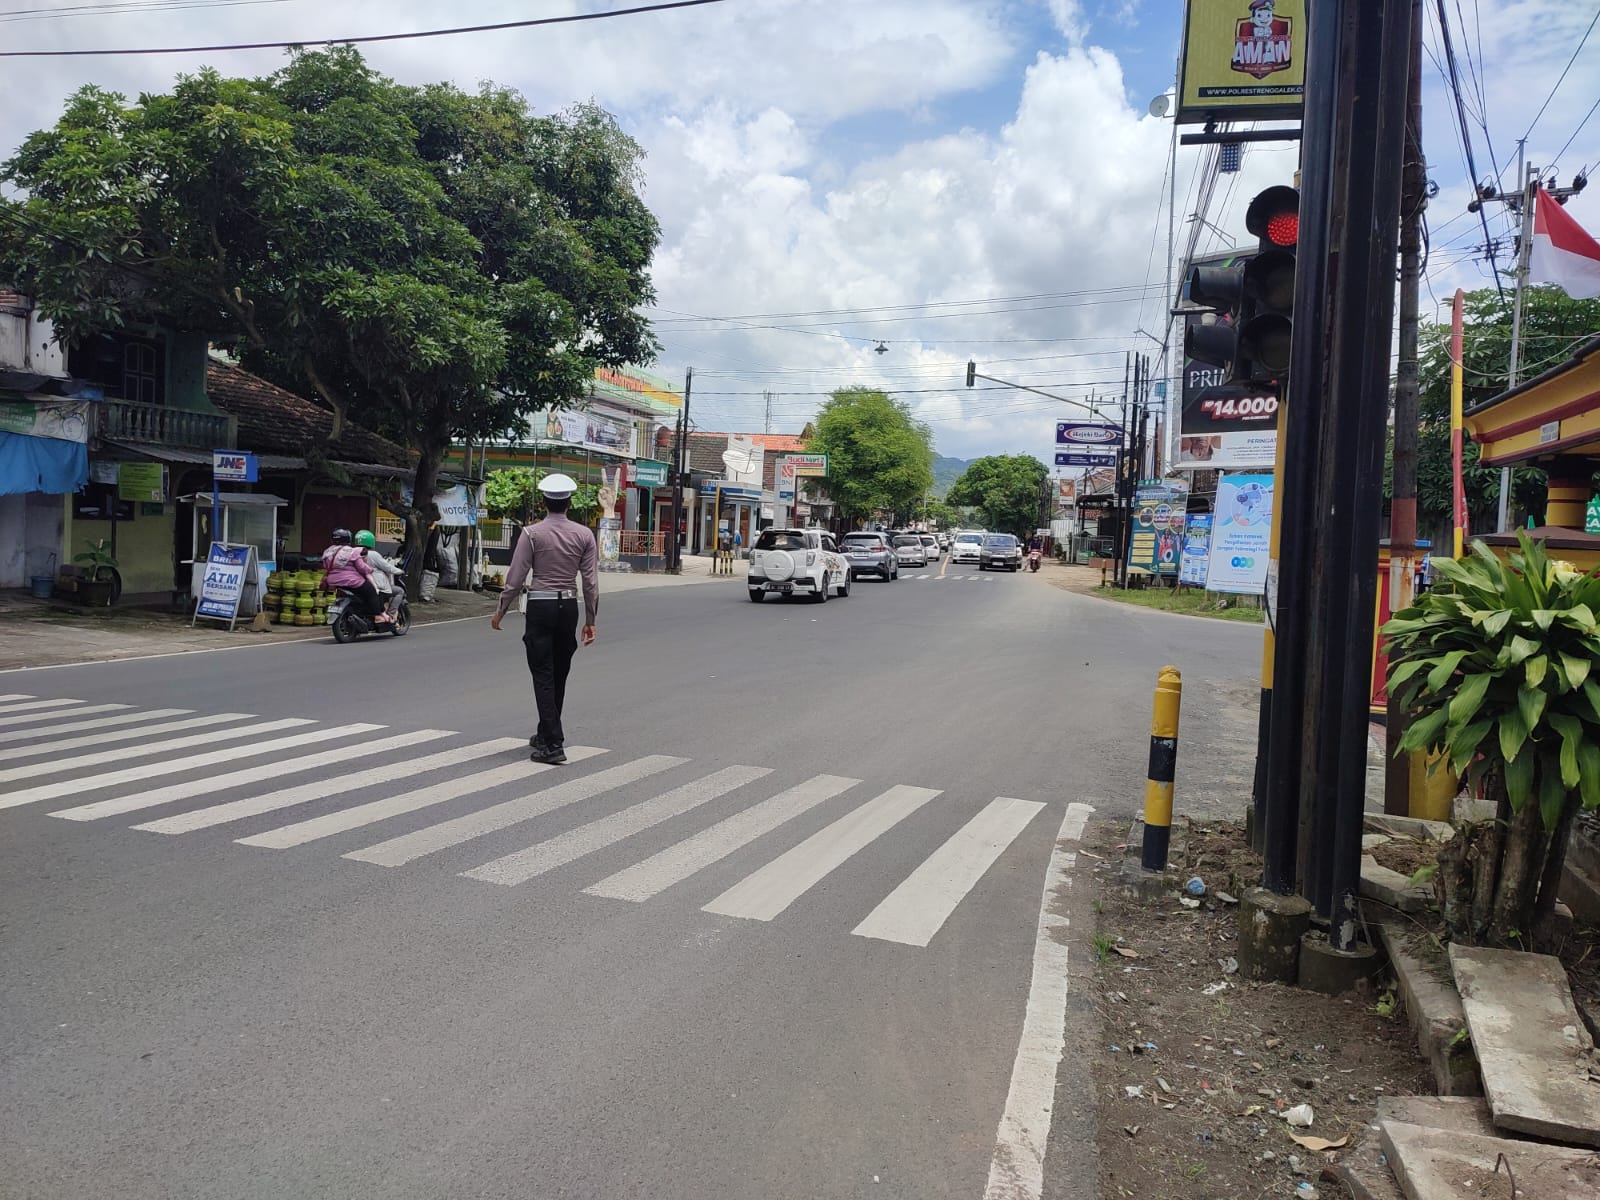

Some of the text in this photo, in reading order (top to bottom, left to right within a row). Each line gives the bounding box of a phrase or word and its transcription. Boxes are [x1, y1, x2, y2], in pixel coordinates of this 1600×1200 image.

[1232, 40, 1291, 64] AMAN
[1214, 396, 1278, 415] 14.000
[216, 456, 245, 469] JNE
[207, 572, 239, 585] ATM
[206, 583, 237, 591] BERSAMA
